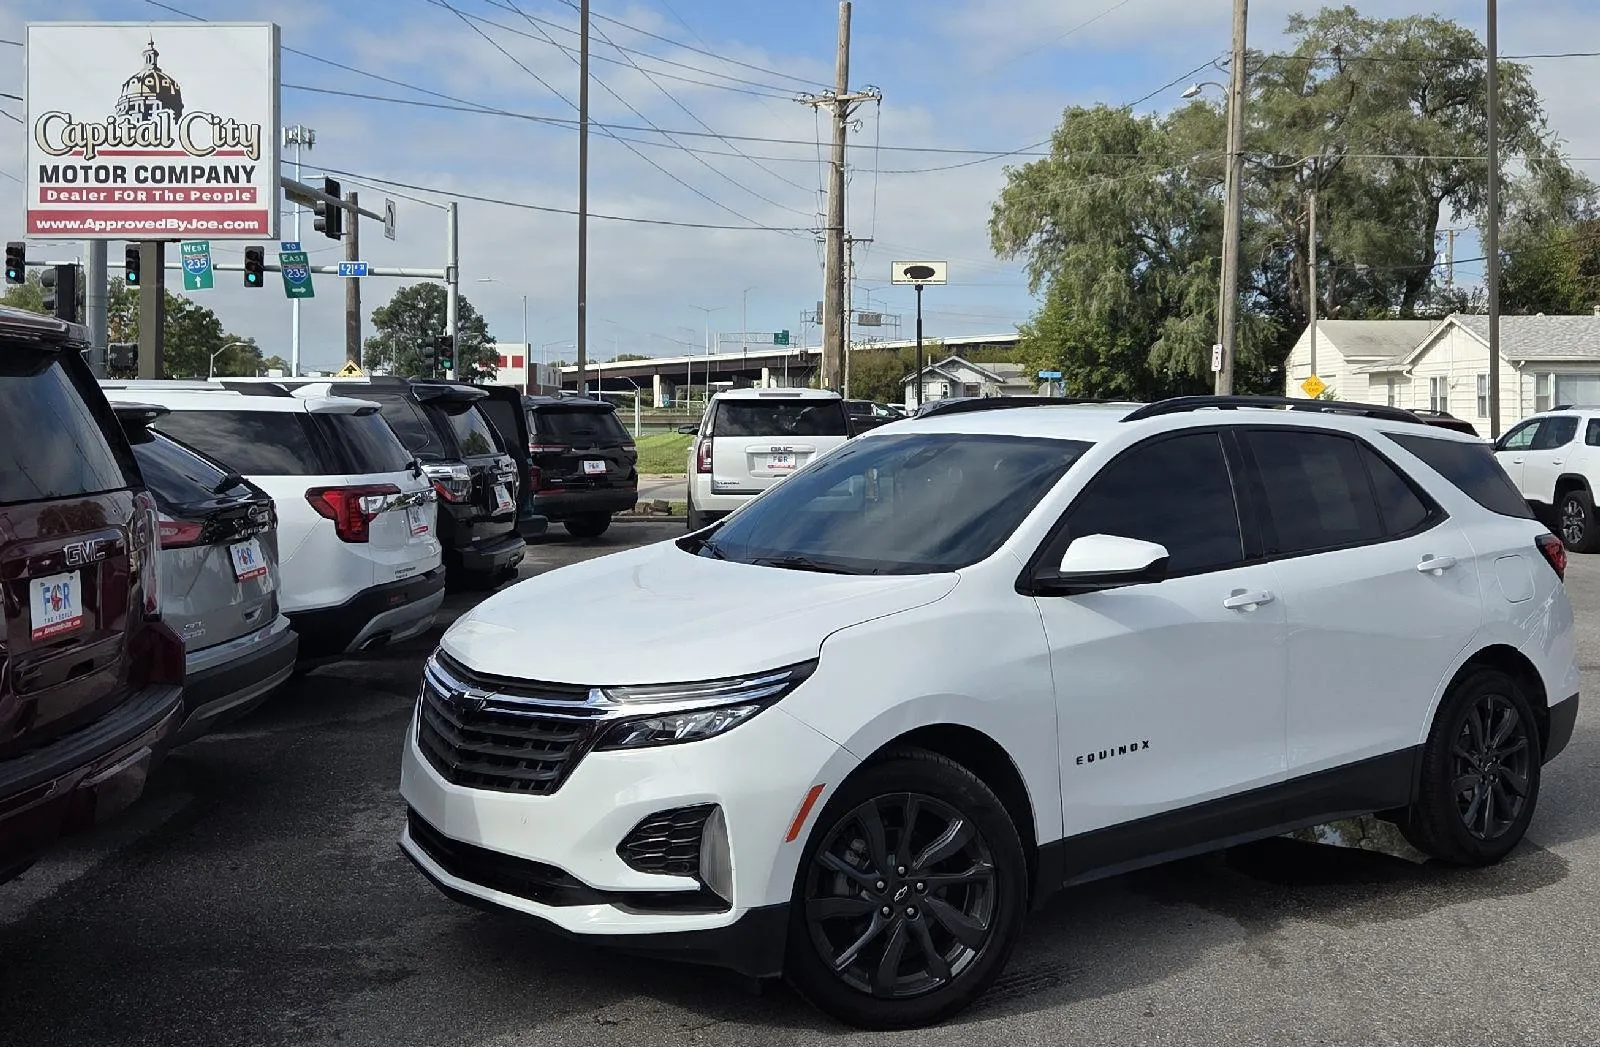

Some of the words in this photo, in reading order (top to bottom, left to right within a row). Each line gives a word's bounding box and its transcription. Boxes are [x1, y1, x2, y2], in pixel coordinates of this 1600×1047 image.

[35, 111, 175, 160] Capital
[179, 111, 261, 160] City
[39, 165, 127, 183] MOTOR
[135, 165, 256, 184] COMPANY
[47, 190, 107, 201] Dealer
[114, 190, 147, 201] FOR
[153, 190, 184, 201] The
[190, 190, 252, 203] People
[36, 218, 259, 234] www.ApprovedByJoe.com
[183, 244, 207, 253] WEST
[187, 258, 207, 269] 235
[281, 254, 304, 262] EAST
[287, 268, 307, 278] 235
[63, 538, 106, 567] GMC
[1076, 740, 1149, 765] EQUINOX
